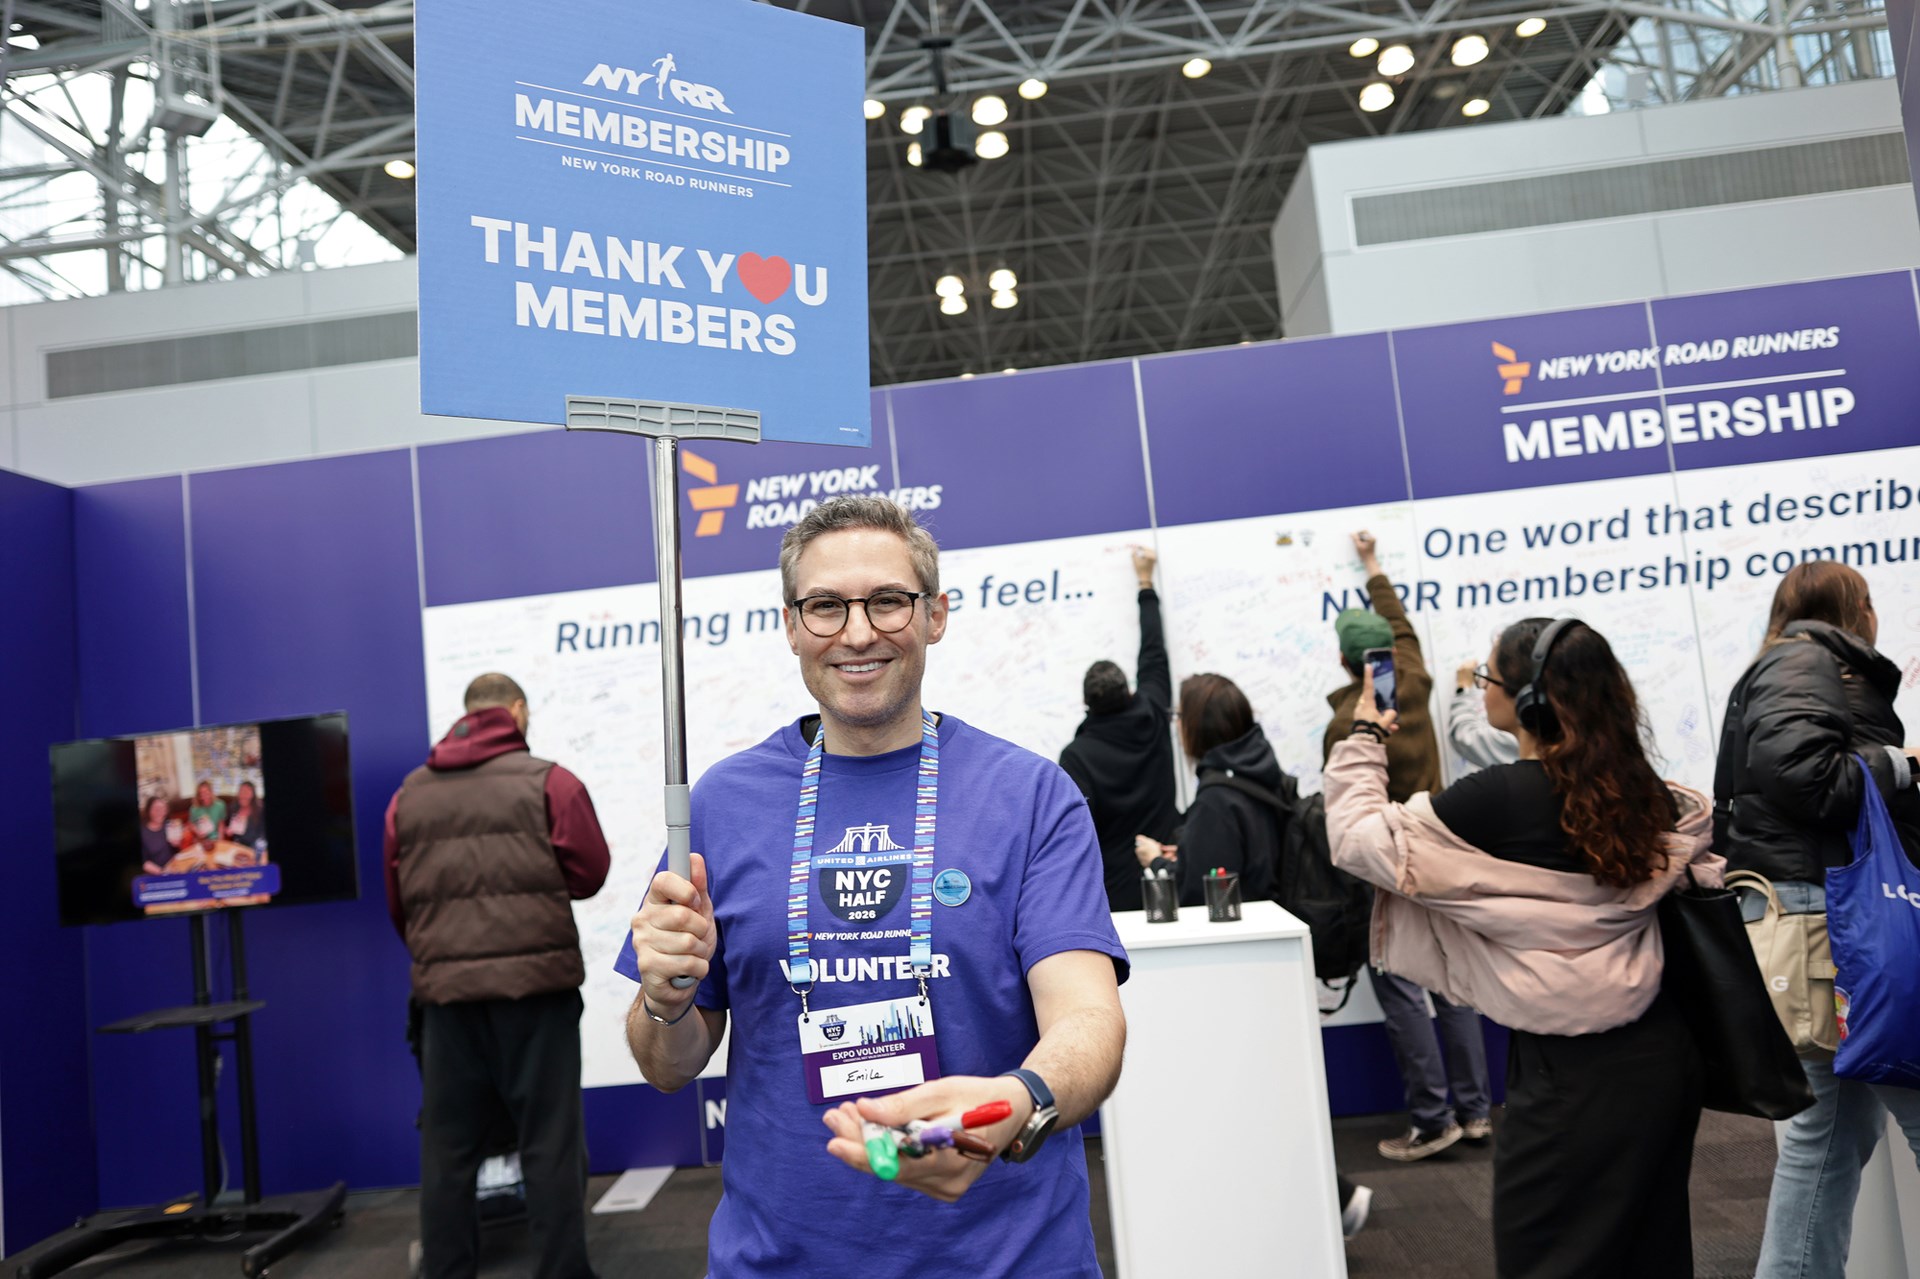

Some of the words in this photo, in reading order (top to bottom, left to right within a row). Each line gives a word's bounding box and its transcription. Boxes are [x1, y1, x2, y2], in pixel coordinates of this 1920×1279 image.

[515, 93, 790, 173] MEMBERSHIP
[562, 155, 597, 171] NEW
[601, 162, 640, 179] YORK
[645, 170, 685, 186] ROAD
[689, 178, 754, 198] RUNNERS
[471, 215, 686, 288] THANK
[515, 281, 797, 356] MEMBERS
[1538, 354, 1593, 381] NEW
[1595, 346, 1661, 374] YORK
[1664, 339, 1729, 366] ROAD
[1731, 326, 1840, 358] RUNNERS
[1503, 387, 1856, 463] MEMBERSHIP
[746, 473, 806, 503] NEW
[809, 464, 880, 495] YORK
[1424, 528, 1507, 558] One
[1523, 508, 1630, 548] word
[1646, 499, 1733, 535] that
[1748, 479, 1920, 524] describ
[1457, 551, 1730, 608] membership
[556, 611, 730, 653] Runnng
[980, 570, 1094, 609] feel...
[817, 857, 854, 865] UNITED
[866, 854, 912, 863] AIRLINES
[835, 869, 892, 891] NYC
[839, 890, 887, 907] HALF
[848, 910, 876, 920] 2026
[815, 932, 836, 941] NEW
[836, 932, 860, 941] YORK
[860, 931, 884, 940] ROAD
[884, 929, 912, 939] RUNNE
[832, 1049, 855, 1060] EXPO
[856, 1043, 905, 1057] VOLUNTEER
